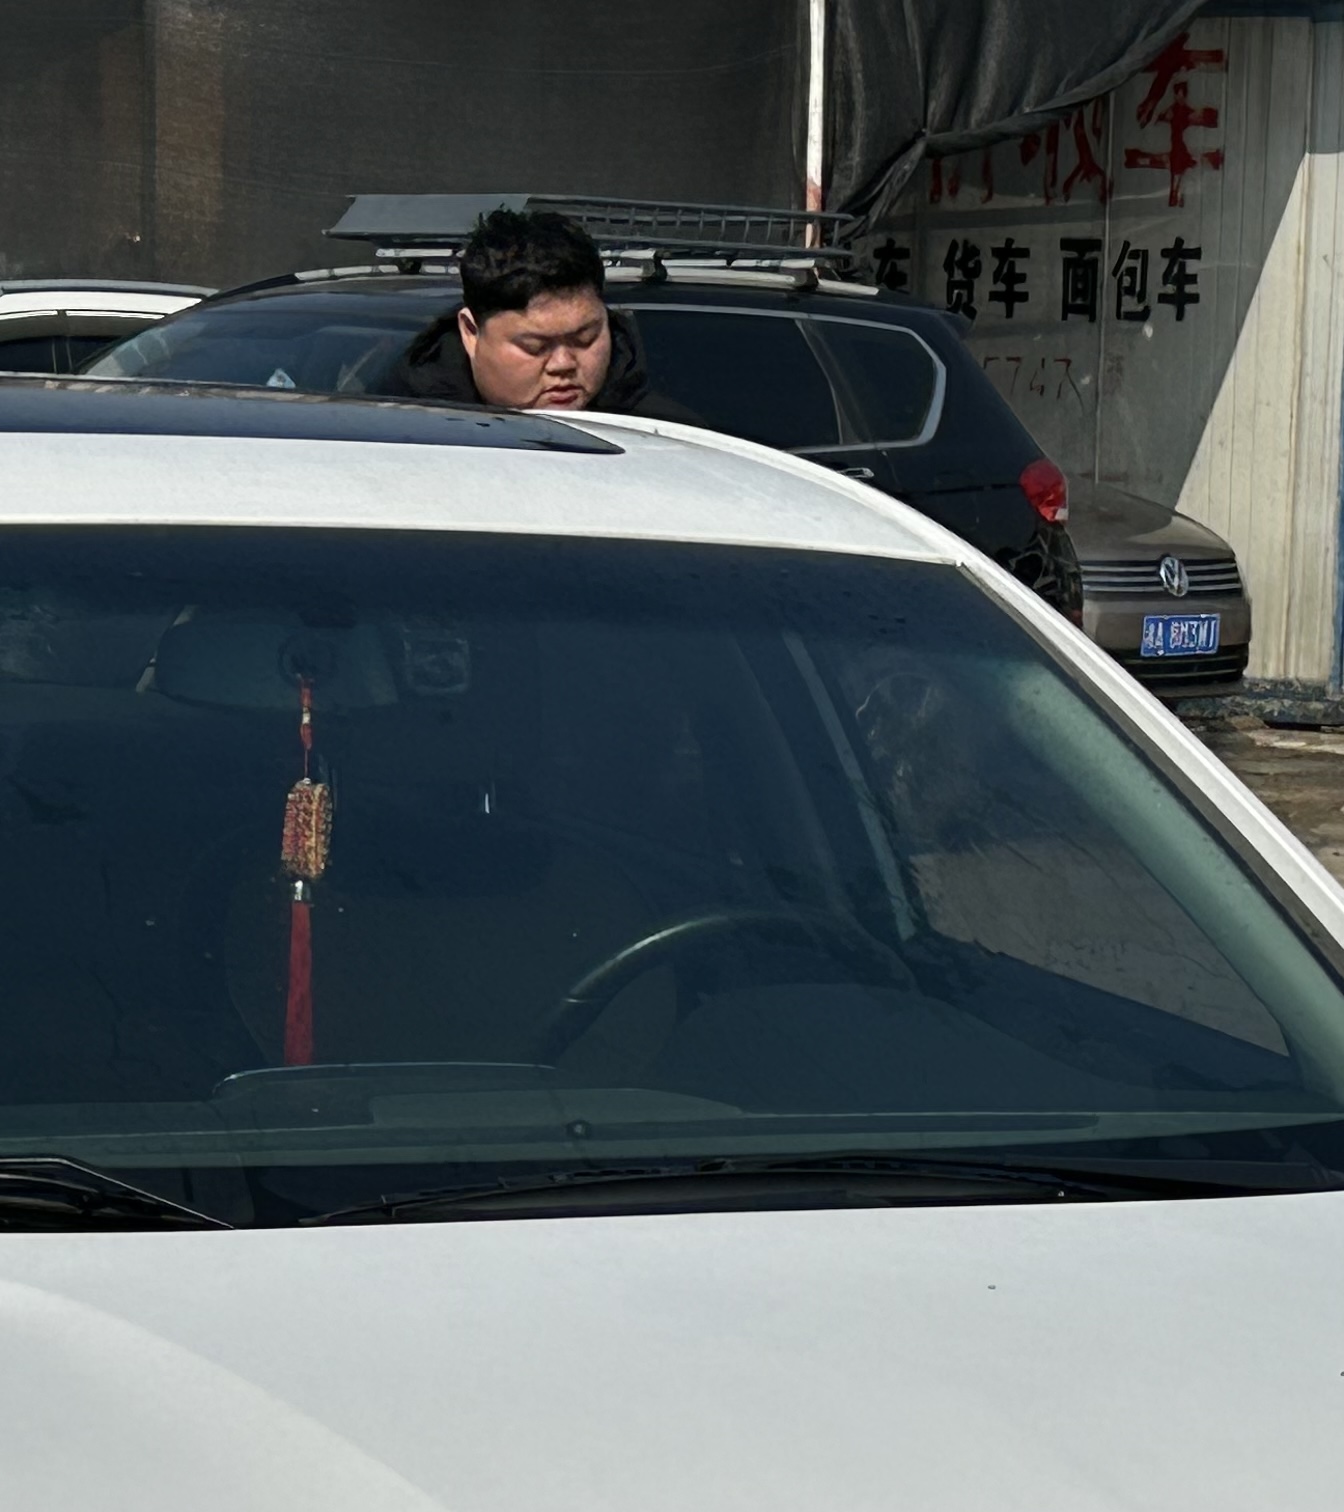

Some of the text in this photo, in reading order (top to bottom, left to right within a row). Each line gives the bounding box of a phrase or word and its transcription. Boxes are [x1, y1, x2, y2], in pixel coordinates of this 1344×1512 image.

[943, 238, 1031, 321] 货车
[1059, 236, 1202, 322] 面包车
